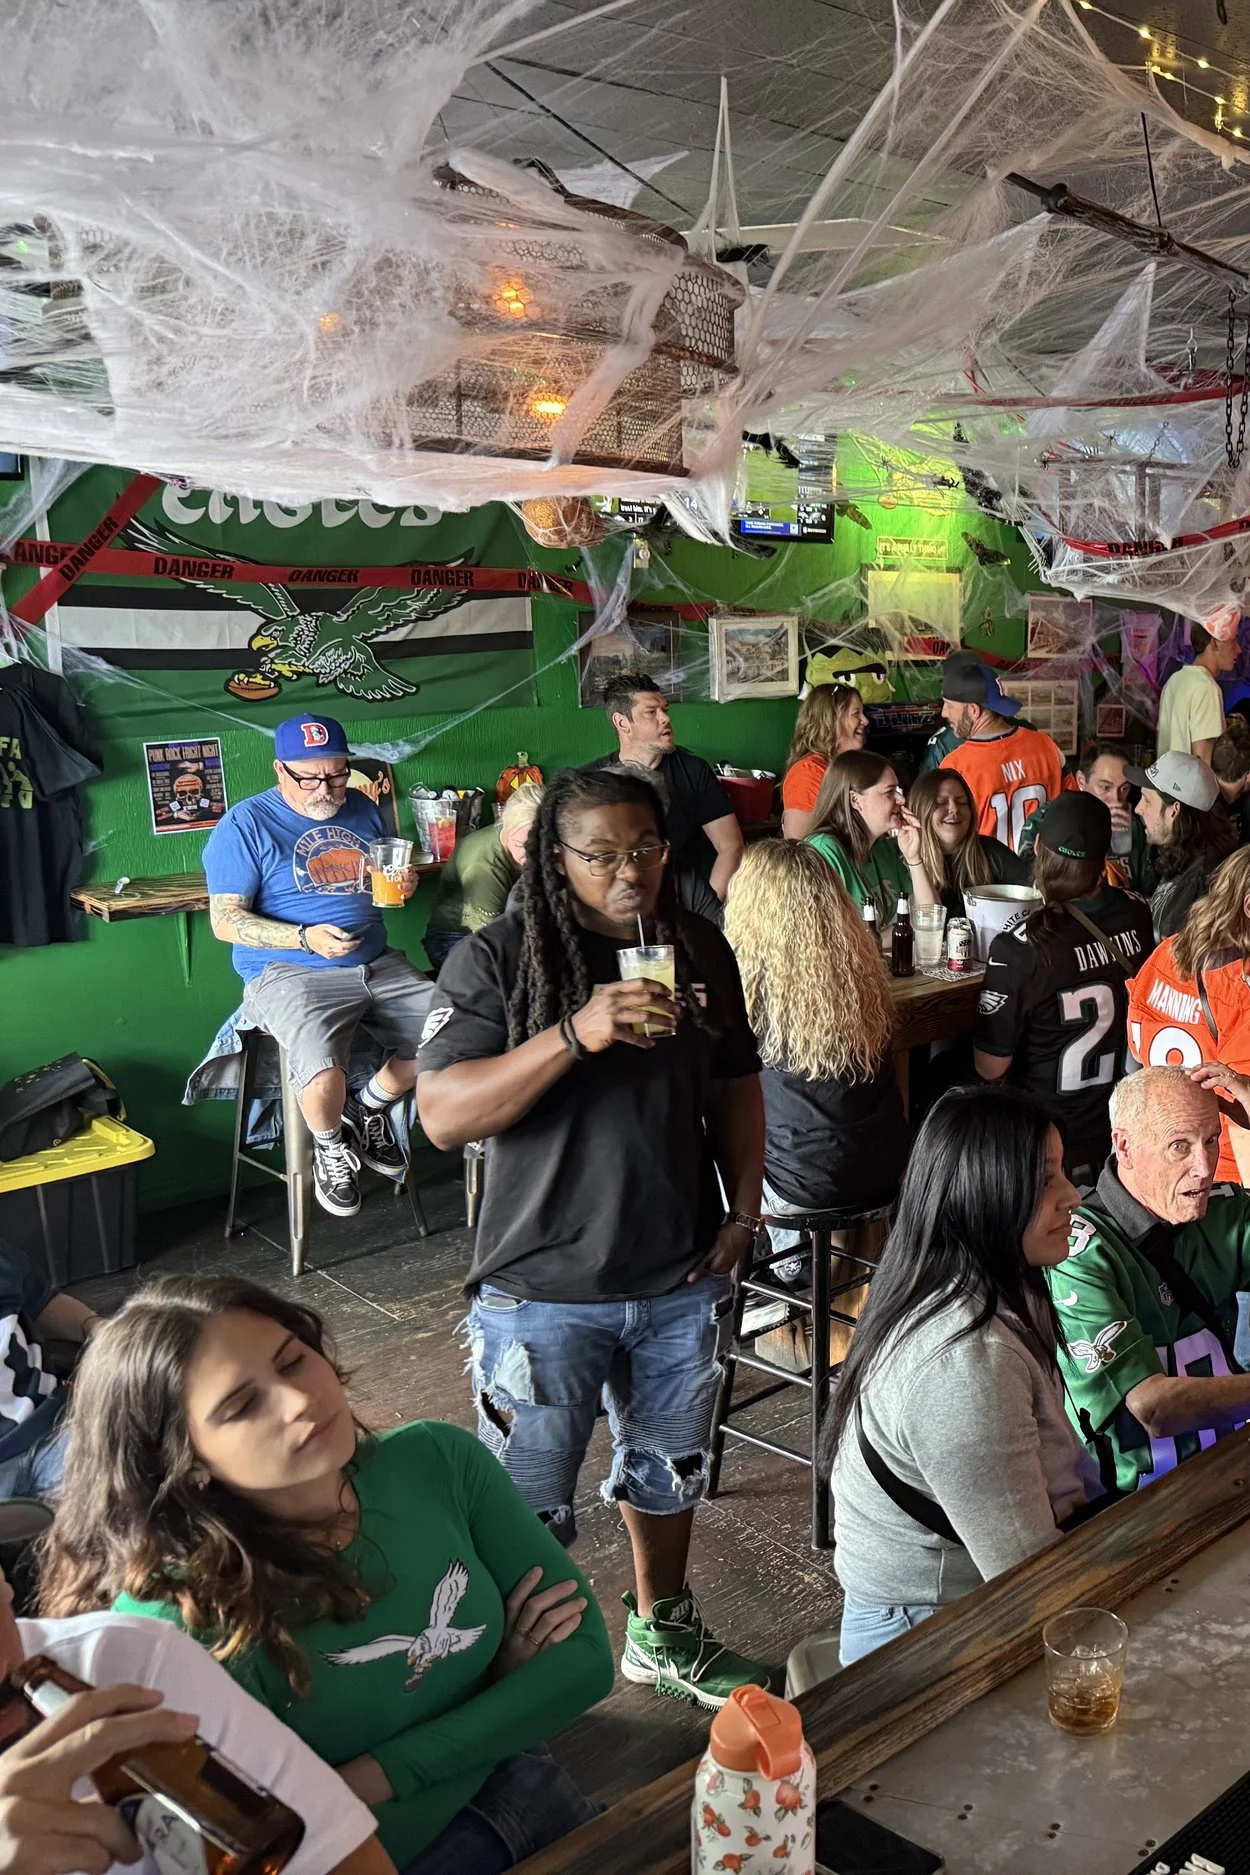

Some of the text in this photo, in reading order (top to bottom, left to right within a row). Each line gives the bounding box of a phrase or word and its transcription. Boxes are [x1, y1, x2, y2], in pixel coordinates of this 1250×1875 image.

[14, 541, 70, 566] ANGE
[59, 516, 119, 582] DANGER
[153, 557, 235, 580] DANGER
[288, 569, 360, 584] DANGER
[411, 569, 475, 588] DANGER
[1001, 759, 1026, 784] NIX
[1003, 912, 1020, 931] HITE
[1146, 978, 1201, 1025] MANNING
